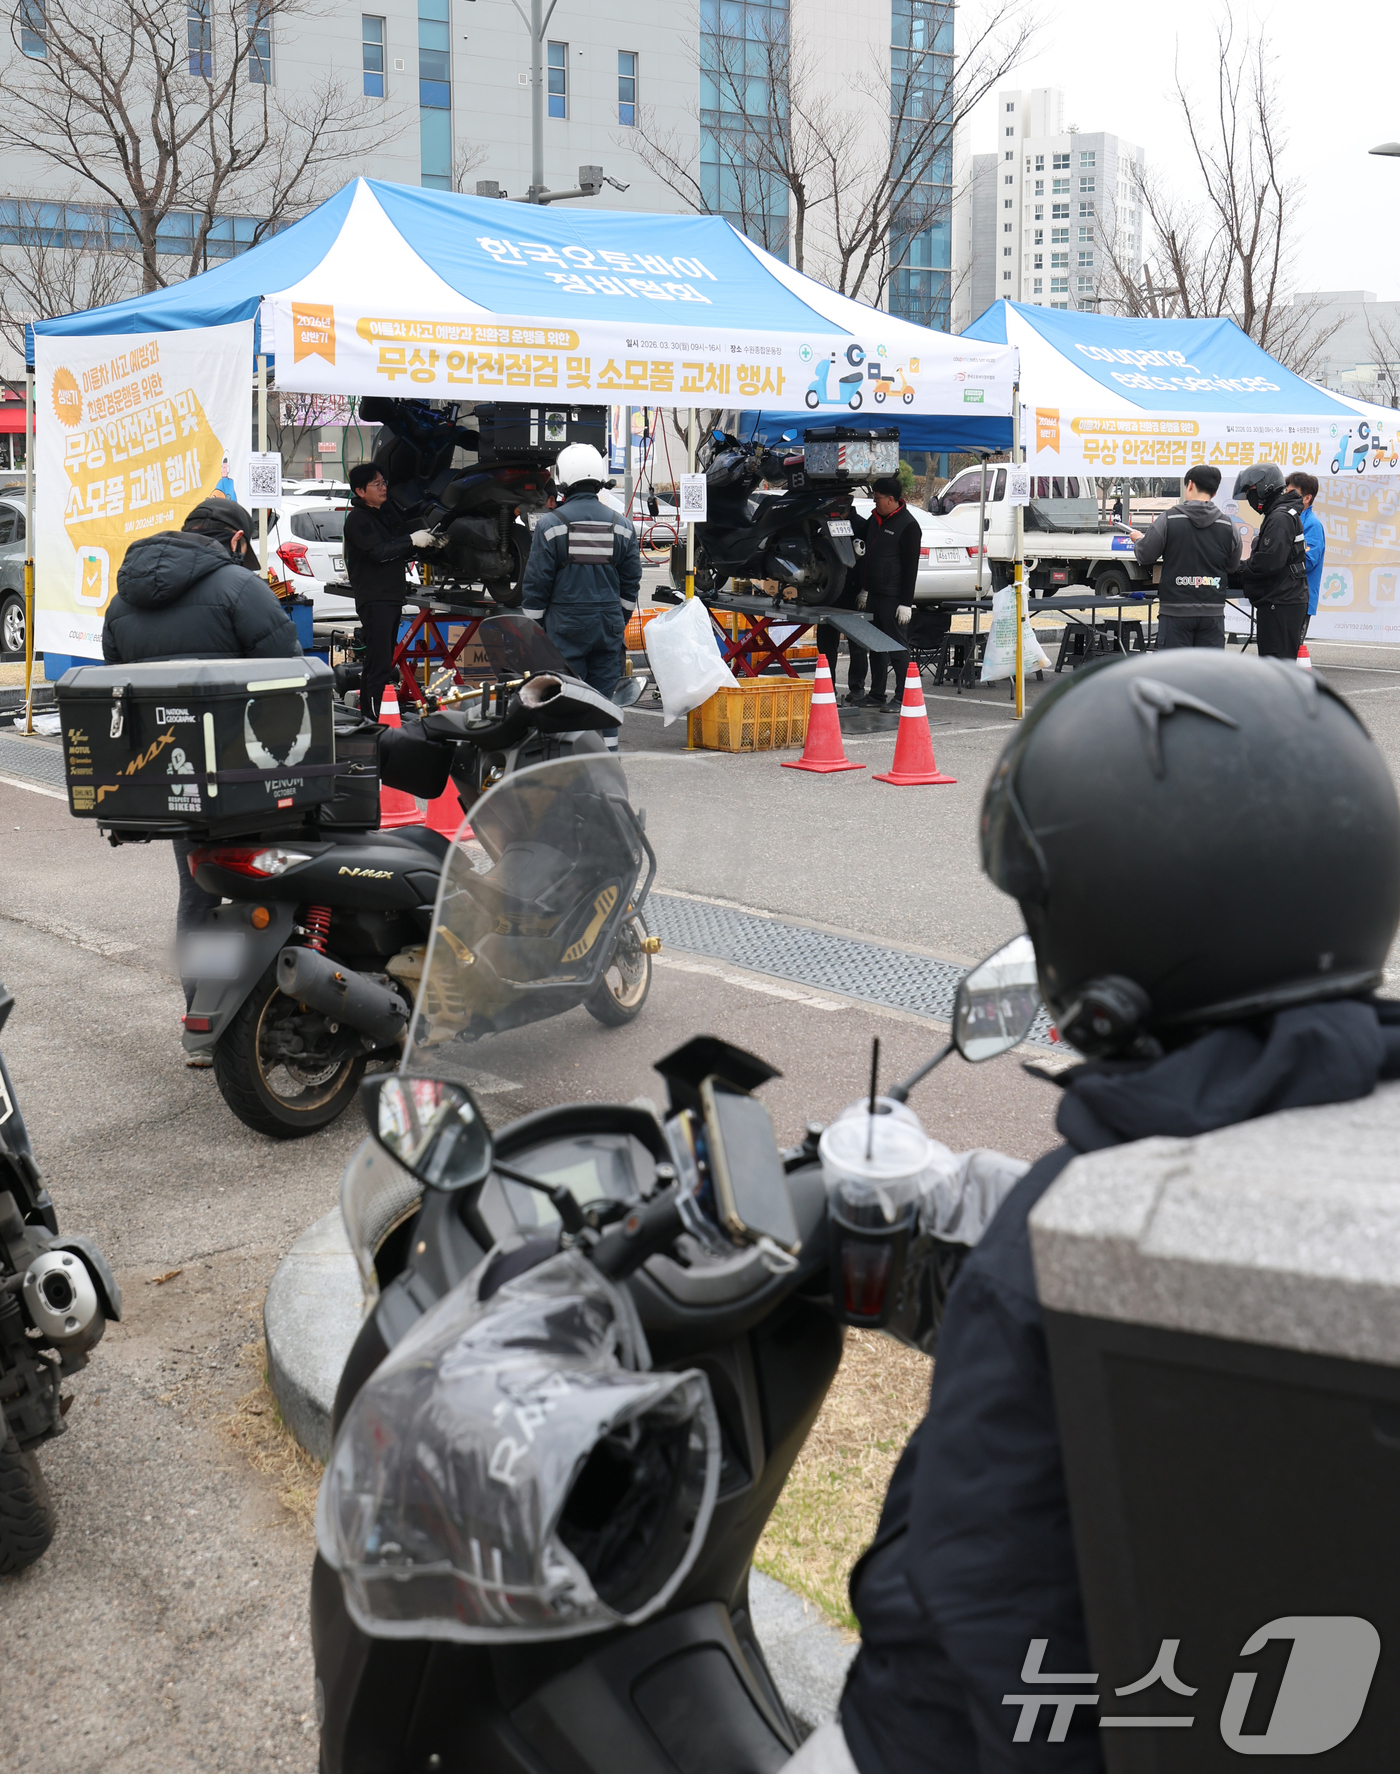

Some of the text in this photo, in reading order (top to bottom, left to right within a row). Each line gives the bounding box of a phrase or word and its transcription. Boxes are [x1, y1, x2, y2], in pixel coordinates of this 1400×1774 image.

[476, 237, 718, 281] 한국오토바이
[544, 272, 713, 304] 정비협회
[297, 315, 331, 329] 2026년
[301, 331, 328, 344] 상반기
[369, 321, 570, 346] 이륜차 사고 예방과 친환경 운행을 위한
[625, 338, 639, 348] 일시
[640, 340, 659, 349] 2026.
[730, 344, 742, 353] 장소
[744, 345, 782, 356] 수원종합운동장
[82, 339, 160, 394] 이륜차 사고 예방과
[1074, 343, 1201, 374] coupang
[376, 346, 786, 397] 무상 안전점검 및 소모품 교체 행사
[141, 372, 163, 401] 위한
[1110, 371, 1281, 392] eats services
[57, 388, 79, 405] 상반기
[65, 388, 199, 474] 무상 안전점검 및
[1101, 420, 1116, 432] 사고
[1180, 420, 1194, 433] 위한
[1083, 439, 1322, 466] 무상 안전점검 및 소모품 교체 행사
[64, 447, 203, 526] 소모품 교체 행사
[1175, 576, 1221, 589] coupang
[69, 630, 94, 643] coupang
[166, 708, 190, 716] NATIONAL
[166, 715, 196, 723] GEOGRAPHIC
[69, 746, 91, 754] MOTUL
[264, 777, 304, 793] VENOM
[273, 787, 297, 798] OCTOBER
[168, 803, 202, 812] BIKERS
[338, 866, 394, 879] NMAX
